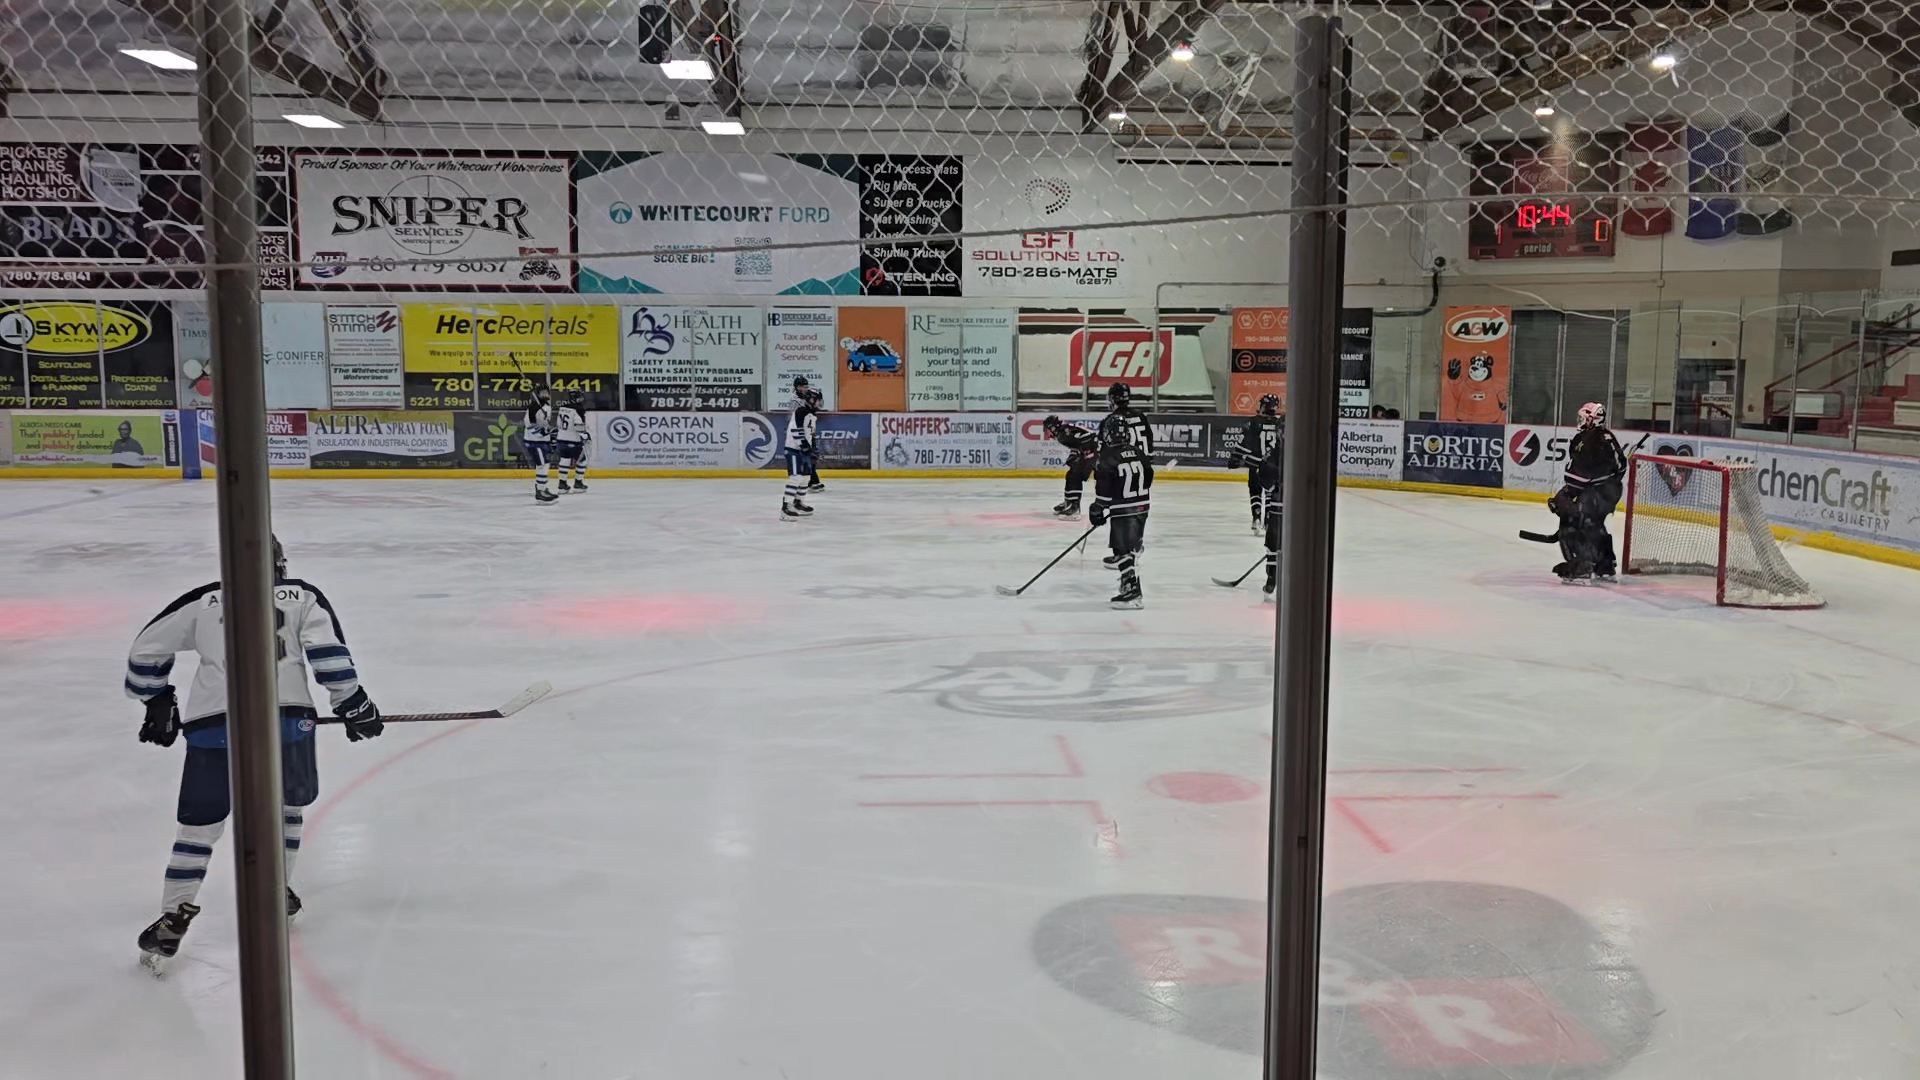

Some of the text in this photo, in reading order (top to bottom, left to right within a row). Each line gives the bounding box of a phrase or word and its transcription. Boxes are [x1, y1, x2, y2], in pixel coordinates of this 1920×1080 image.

[0, 147, 68, 160] PICKERS
[0, 160, 65, 172] CRANES
[300, 158, 565, 174] Proud Sponsor Of Your Whitecourt Wolverines
[894, 163, 932, 175] Access
[1, 173, 74, 186] HAULING
[2, 186, 79, 200] HOTSHOT
[872, 180, 917, 193] Rig Mats
[873, 197, 904, 210] Super
[905, 197, 914, 208] B
[331, 194, 535, 240] SNIPER
[638, 204, 831, 224] WHITECOURT FORD
[873, 213, 940, 228] Mat Washing
[1516, 203, 1571, 229] 10:44
[19, 215, 137, 243] BRADS
[394, 227, 464, 238] SERVICES
[1021, 231, 1075, 249] GFI
[873, 247, 947, 259] Shuttle Trucks
[1523, 242, 1552, 255] period
[653, 254, 689, 264] SCORE
[971, 249, 1125, 263] SOLUTIONS LTD.
[884, 272, 956, 283] STERLING
[978, 266, 1118, 279] 780-286-MATS
[1075, 277, 1113, 286] (6287)
[328, 313, 376, 324] STITCH
[435, 314, 588, 336] HercRentals
[674, 315, 742, 329] HEALTH
[767, 312, 782, 327] HB
[911, 315, 938, 331] RF
[35, 320, 134, 337] SKYWAY
[1453, 321, 1504, 337] A&W
[694, 332, 760, 346] SAFETY
[782, 332, 818, 341] Tax and
[442, 350, 465, 358] equip
[524, 350, 539, 358] and
[774, 343, 826, 352] Accounting
[920, 345, 998, 356] Helping with all
[276, 350, 325, 361] CONIFER
[781, 353, 819, 361] Services
[926, 357, 990, 367] your tax and
[1077, 341, 1165, 378] IGA
[666, 359, 710, 367] TRAINING
[632, 367, 663, 375] HEALTH
[673, 367, 705, 375] SAFETY
[706, 367, 754, 375] PROGRAMS
[914, 368, 969, 379] accounting
[971, 368, 1005, 378] needs.
[31, 374, 99, 383] DIGITAL SCANNING
[49, 384, 87, 392] PLANNING
[124, 383, 157, 392] COATING
[410, 396, 439, 407] 5221
[443, 396, 474, 407] 59st.
[650, 397, 740, 408] 780-778-4478
[910, 392, 960, 401] 778-3981
[267, 414, 289, 424] FULL
[314, 414, 448, 436] ALTRA SPRAY FOAM
[638, 416, 714, 429] SPARTAN
[266, 424, 294, 434] SERVE
[881, 416, 951, 436] SCHAFFER'S
[950, 422, 974, 434] CUSTOM
[975, 422, 1001, 434] WELDING
[1001, 422, 1014, 434] LTD.
[20, 429, 105, 441] That's publicly funded
[638, 431, 730, 445] CONTROLS
[1150, 424, 1203, 442] WCT
[1340, 431, 1383, 443] Alberta
[26, 441, 41, 450] and
[42, 440, 75, 452] publicly
[316, 438, 448, 447] INSULATION & INDUSTRIAL COATINGS
[463, 426, 518, 462] GFL
[1340, 442, 1397, 456] Newsprint
[1407, 433, 1503, 458] FORTIS
[914, 449, 992, 464] 780-778-5611
[1340, 453, 1395, 469] Company
[1406, 452, 1502, 473] ALBERTA
[1118, 461, 1149, 499] 22
[1726, 455, 1892, 517] chenCraft
[1820, 507, 1891, 532] CABINETRY
